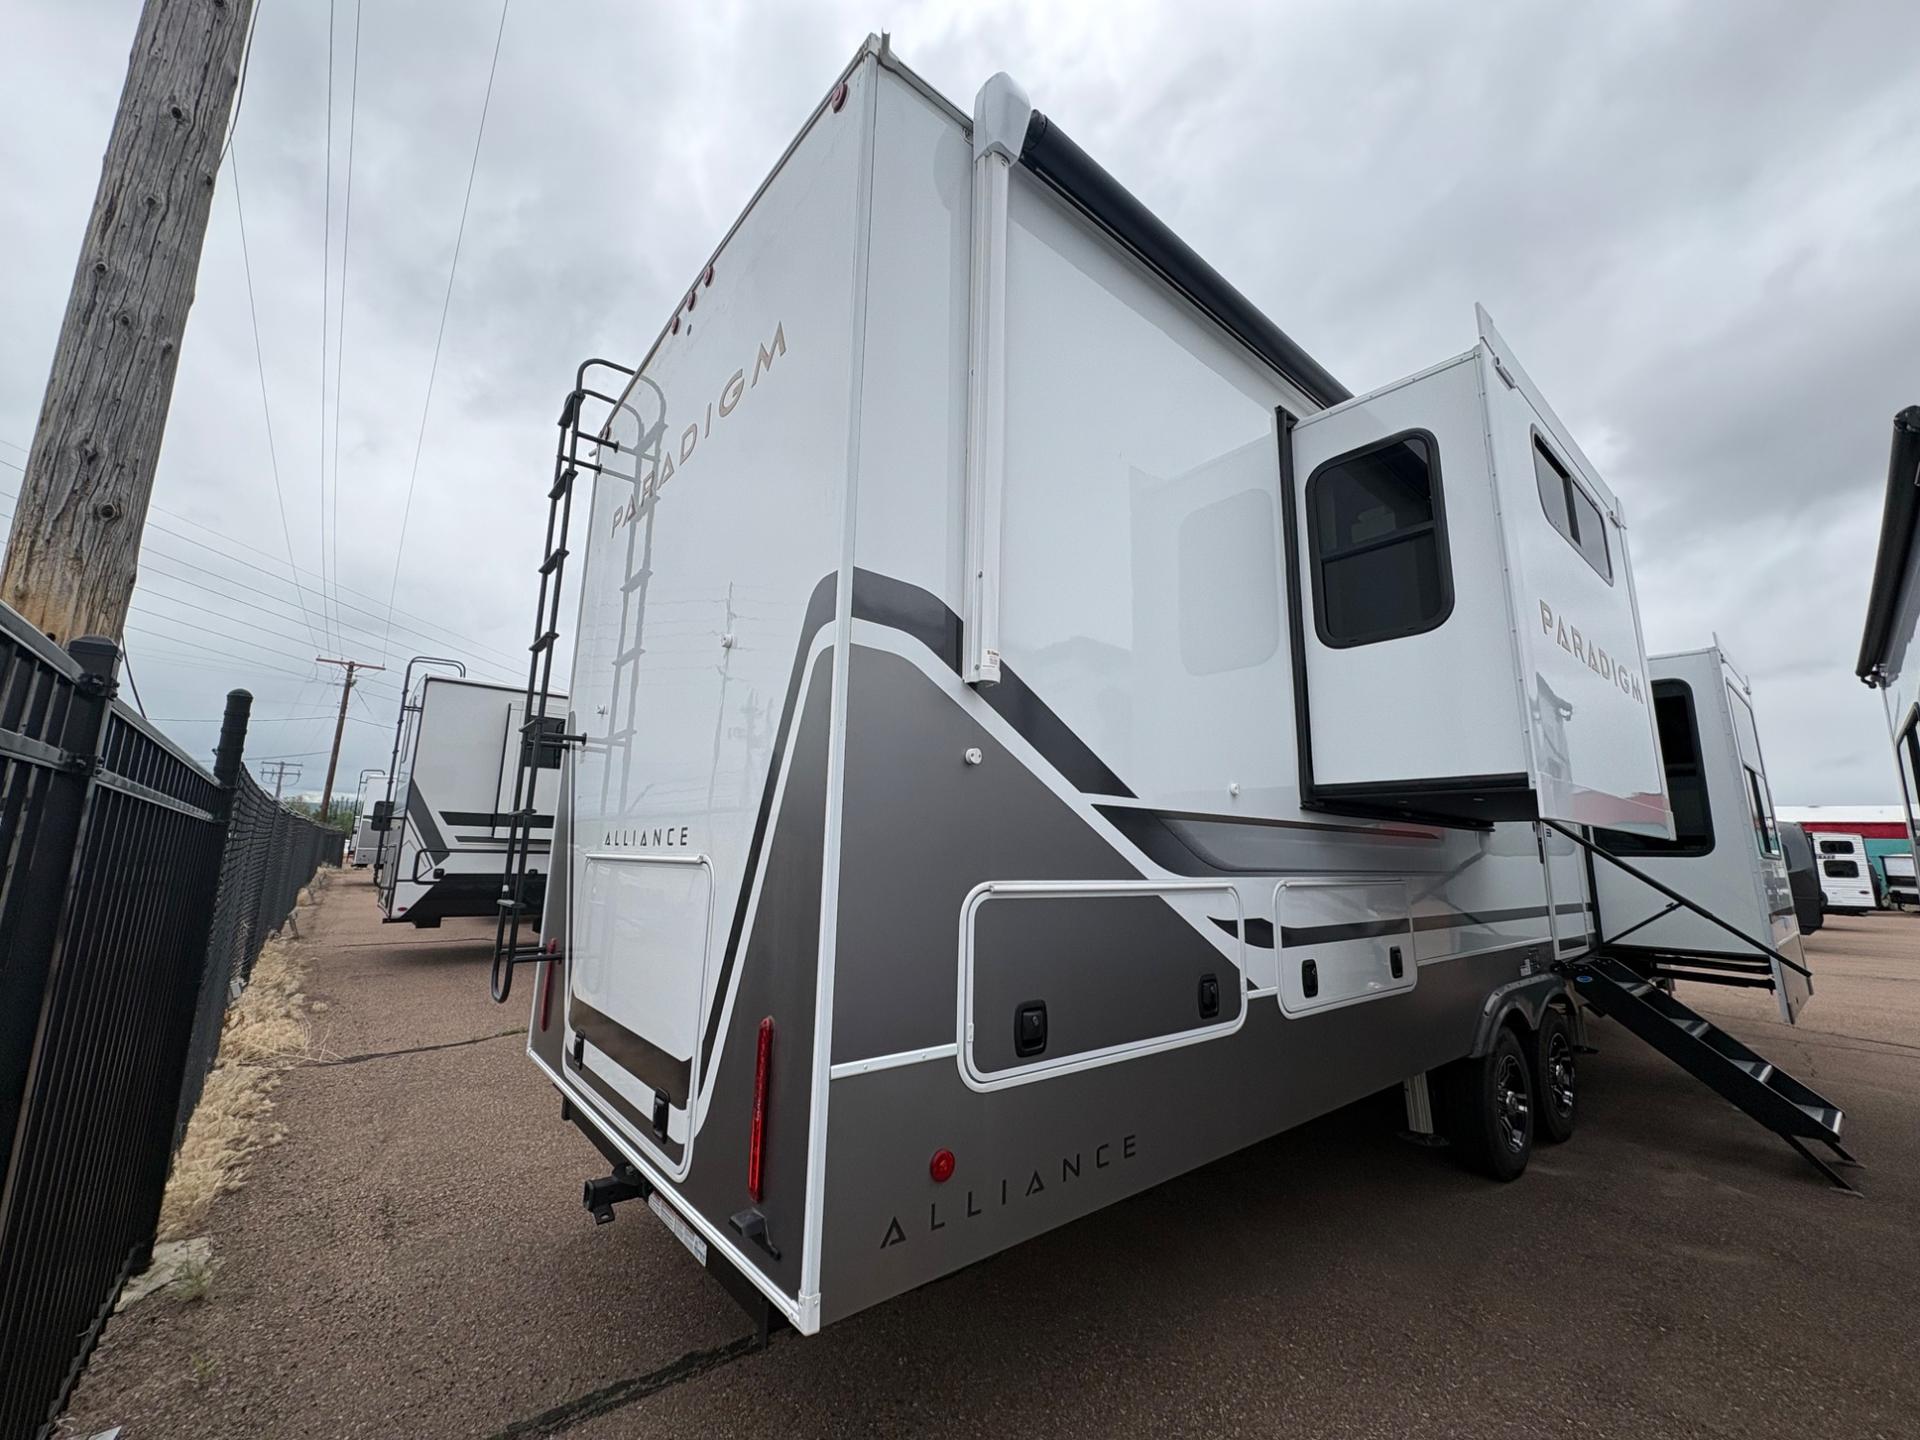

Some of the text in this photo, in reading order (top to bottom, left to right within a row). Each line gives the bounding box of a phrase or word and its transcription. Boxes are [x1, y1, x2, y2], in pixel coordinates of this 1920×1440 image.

[611, 320, 787, 539] PARADIGM
[1539, 599, 1644, 705] PARADIGM
[604, 826, 689, 847] ALLIANCE
[880, 1134, 1136, 1249] ALLIANCE
